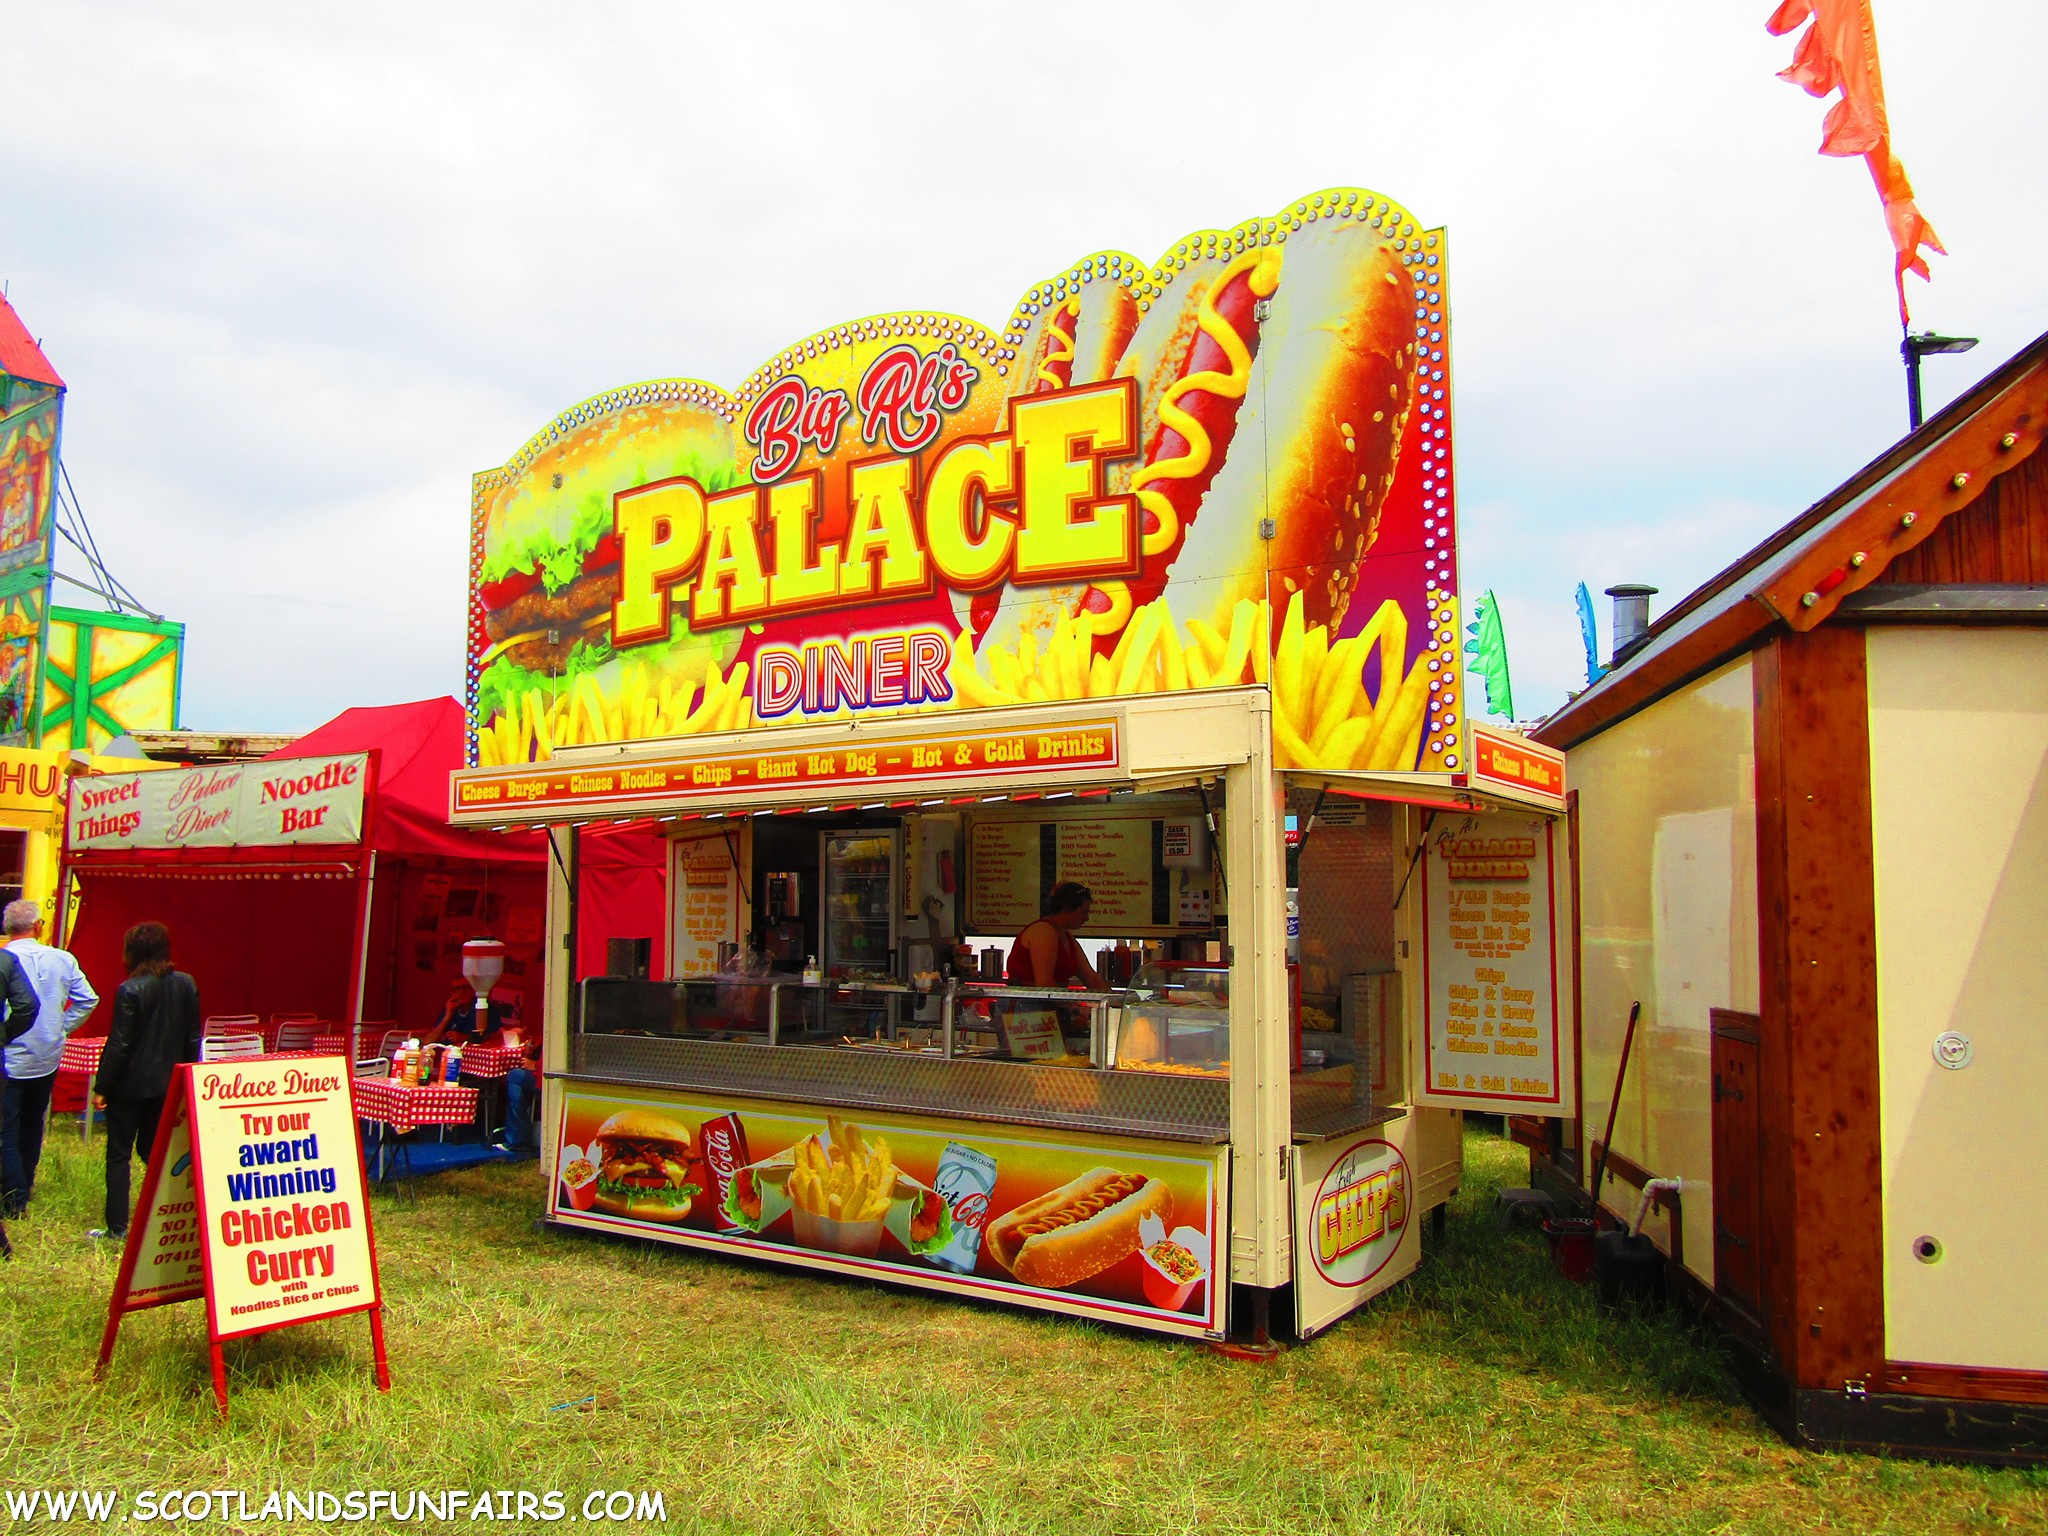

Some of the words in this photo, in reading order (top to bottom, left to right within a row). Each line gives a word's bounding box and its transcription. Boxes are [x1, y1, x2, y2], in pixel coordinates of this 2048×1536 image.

[745, 374, 850, 484] Big
[857, 343, 978, 454] Al's
[612, 376, 1143, 649] PALACE
[757, 632, 953, 718] DINER
[462, 784, 500, 801] Cheese
[507, 781, 548, 800] Burger
[570, 775, 613, 793] Chinese
[620, 771, 666, 790] Noodles
[693, 765, 732, 786] Chips
[757, 757, 798, 779] Giant
[807, 755, 835, 775] Hot
[845, 752, 877, 776] Dog
[912, 746, 943, 768] Hot
[954, 743, 972, 765] &
[984, 739, 1026, 763] Cold
[1037, 733, 1105, 759] Drinks
[1492, 749, 1520, 777] Chinese
[1523, 759, 1550, 786] Noodles
[81, 776, 142, 812] Sweet
[168, 770, 241, 811] Palace
[260, 762, 358, 805] Noodle
[76, 810, 141, 841] Things
[165, 805, 233, 844] Diner
[280, 804, 329, 834] Bar
[1440, 838, 1536, 859] PALACE
[1449, 861, 1529, 879] DINER
[1493, 890, 1531, 907] Burger
[1491, 908, 1529, 925] Burger
[1483, 925, 1503, 940] Hot
[1509, 926, 1531, 944] Dog
[1475, 968, 1505, 985] Chips
[1449, 984, 1478, 1002] Chips
[1484, 986, 1496, 1000] &
[1502, 986, 1534, 1005] Curry
[1449, 1002, 1478, 1020] Chips
[1484, 1004, 1496, 1018] &
[1502, 1004, 1535, 1023] Gravy
[1447, 1020, 1476, 1037] Chips
[1482, 1021, 1493, 1036] &
[1500, 1022, 1538, 1038] Cheese
[1447, 1038, 1488, 1054] Chinese
[1494, 1040, 1538, 1057] Noodles
[202, 1072, 277, 1101] Palace
[283, 1069, 341, 1095] Diner
[1439, 1073, 1458, 1088] Hot
[1464, 1074, 1475, 1089] &
[1481, 1076, 1505, 1091] Cold
[1511, 1077, 1548, 1094] Drinks
[240, 1113, 273, 1136] Try
[277, 1112, 310, 1132] our
[239, 1133, 319, 1167] award
[227, 1167, 337, 1202] Winning
[705, 1128, 739, 1225] Cca-Cola
[157, 1201, 198, 1216] SHO
[220, 1201, 351, 1247] Chicken
[1318, 1162, 1406, 1265] CHIPS
[159, 1231, 201, 1246] 0741
[160, 1220, 185, 1233] NO
[247, 1244, 335, 1286] Curry
[230, 1301, 281, 1315] Noodles
[283, 1294, 309, 1306] Rice
[312, 1292, 323, 1300] or
[326, 1284, 360, 1298] Chips
[281, 1280, 308, 1293] with
